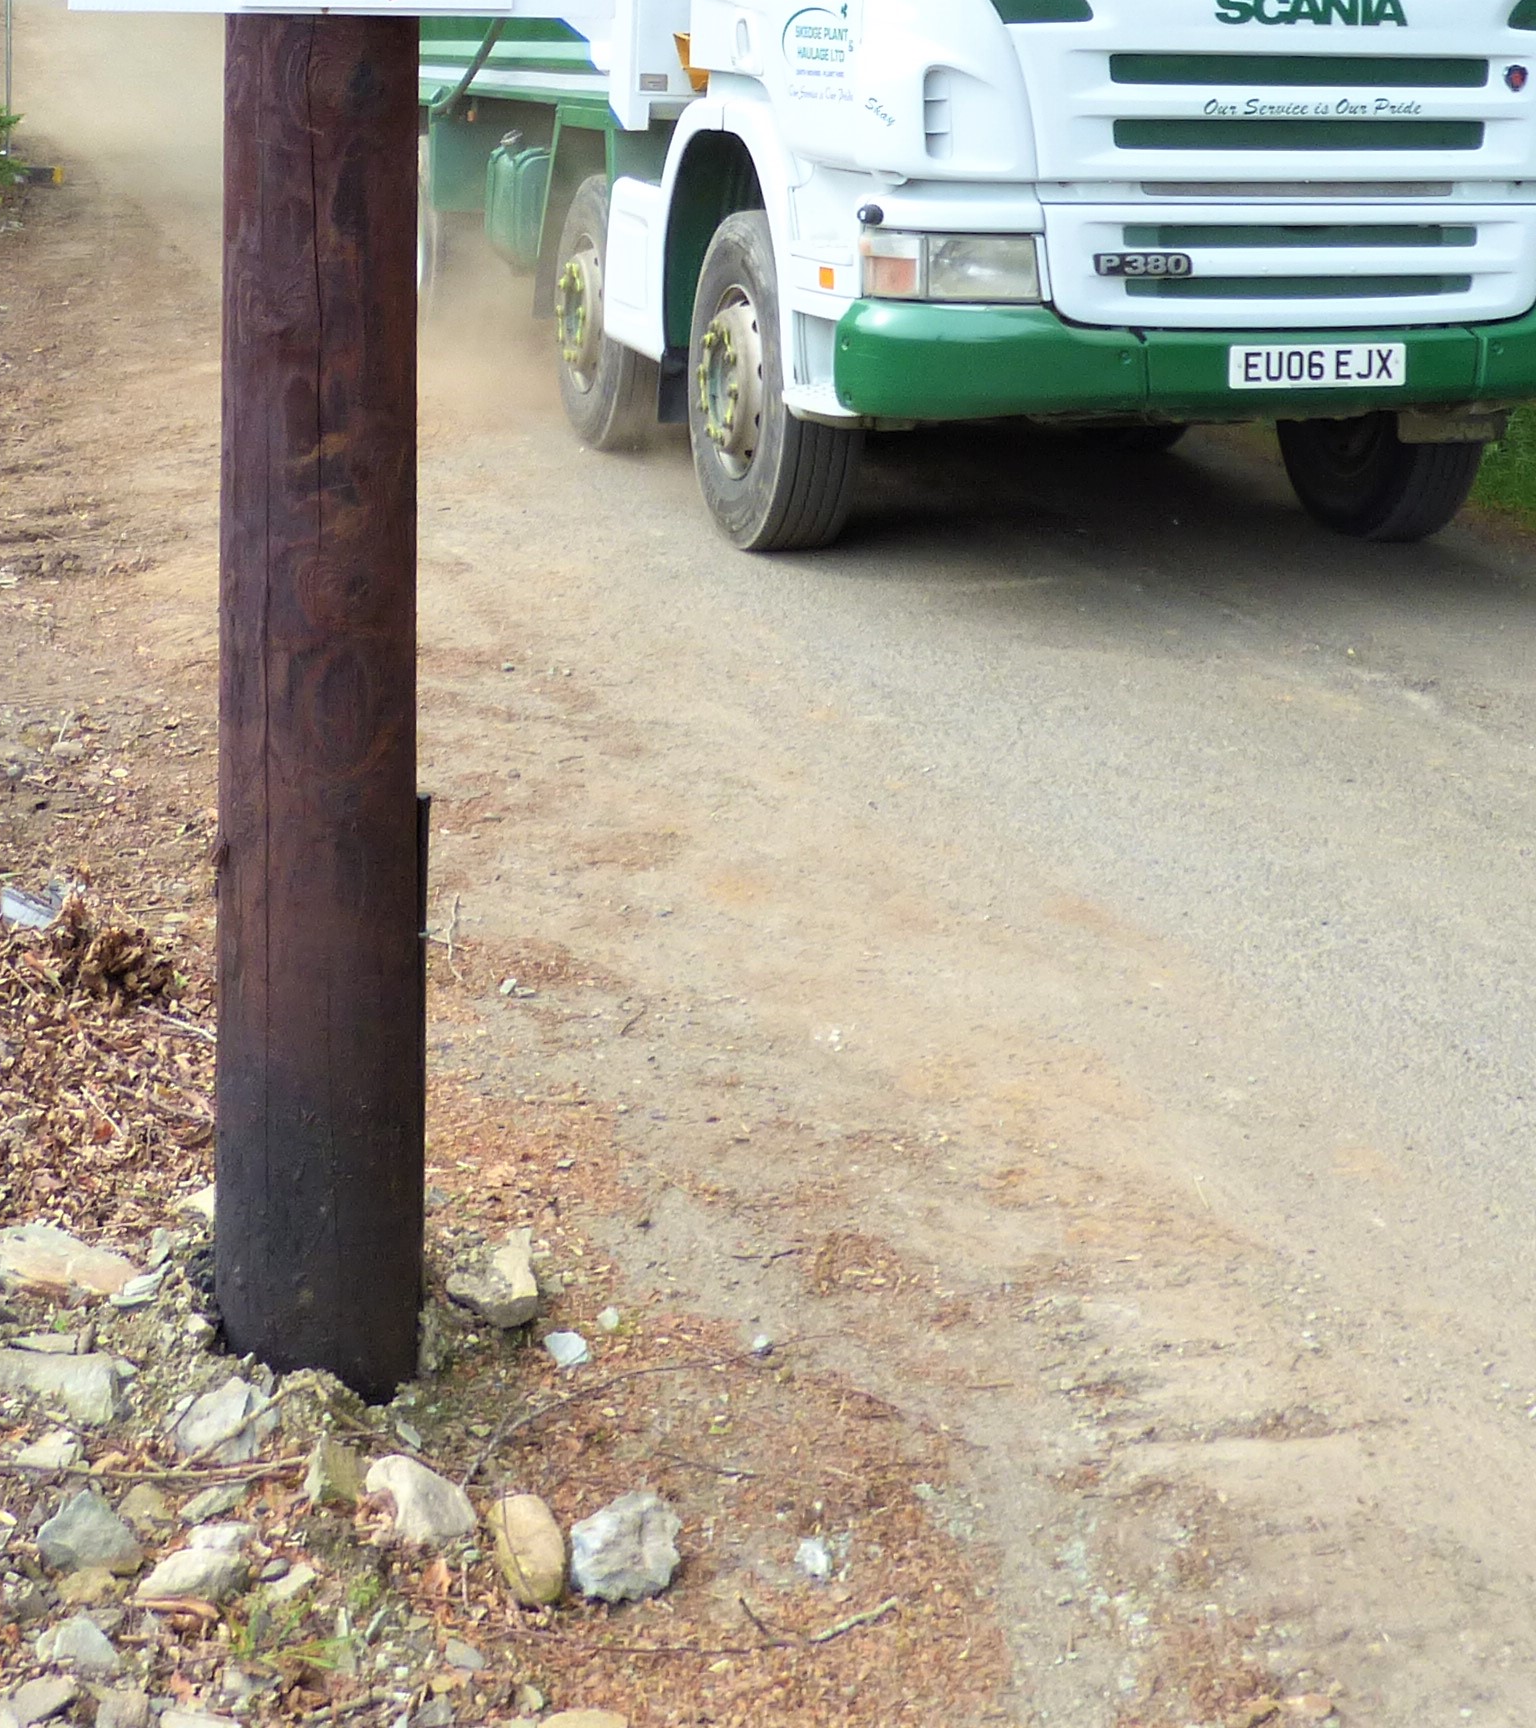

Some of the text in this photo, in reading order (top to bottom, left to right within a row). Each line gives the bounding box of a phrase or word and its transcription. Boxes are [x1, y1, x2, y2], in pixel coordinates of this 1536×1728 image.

[824, 28, 848, 41] PLANT
[830, 49, 845, 62] LTD
[1204, 98, 1422, 115] Our Service is Our Pride
[1099, 254, 1189, 275] P 380
[1243, 349, 1394, 383] EU06 EJX
